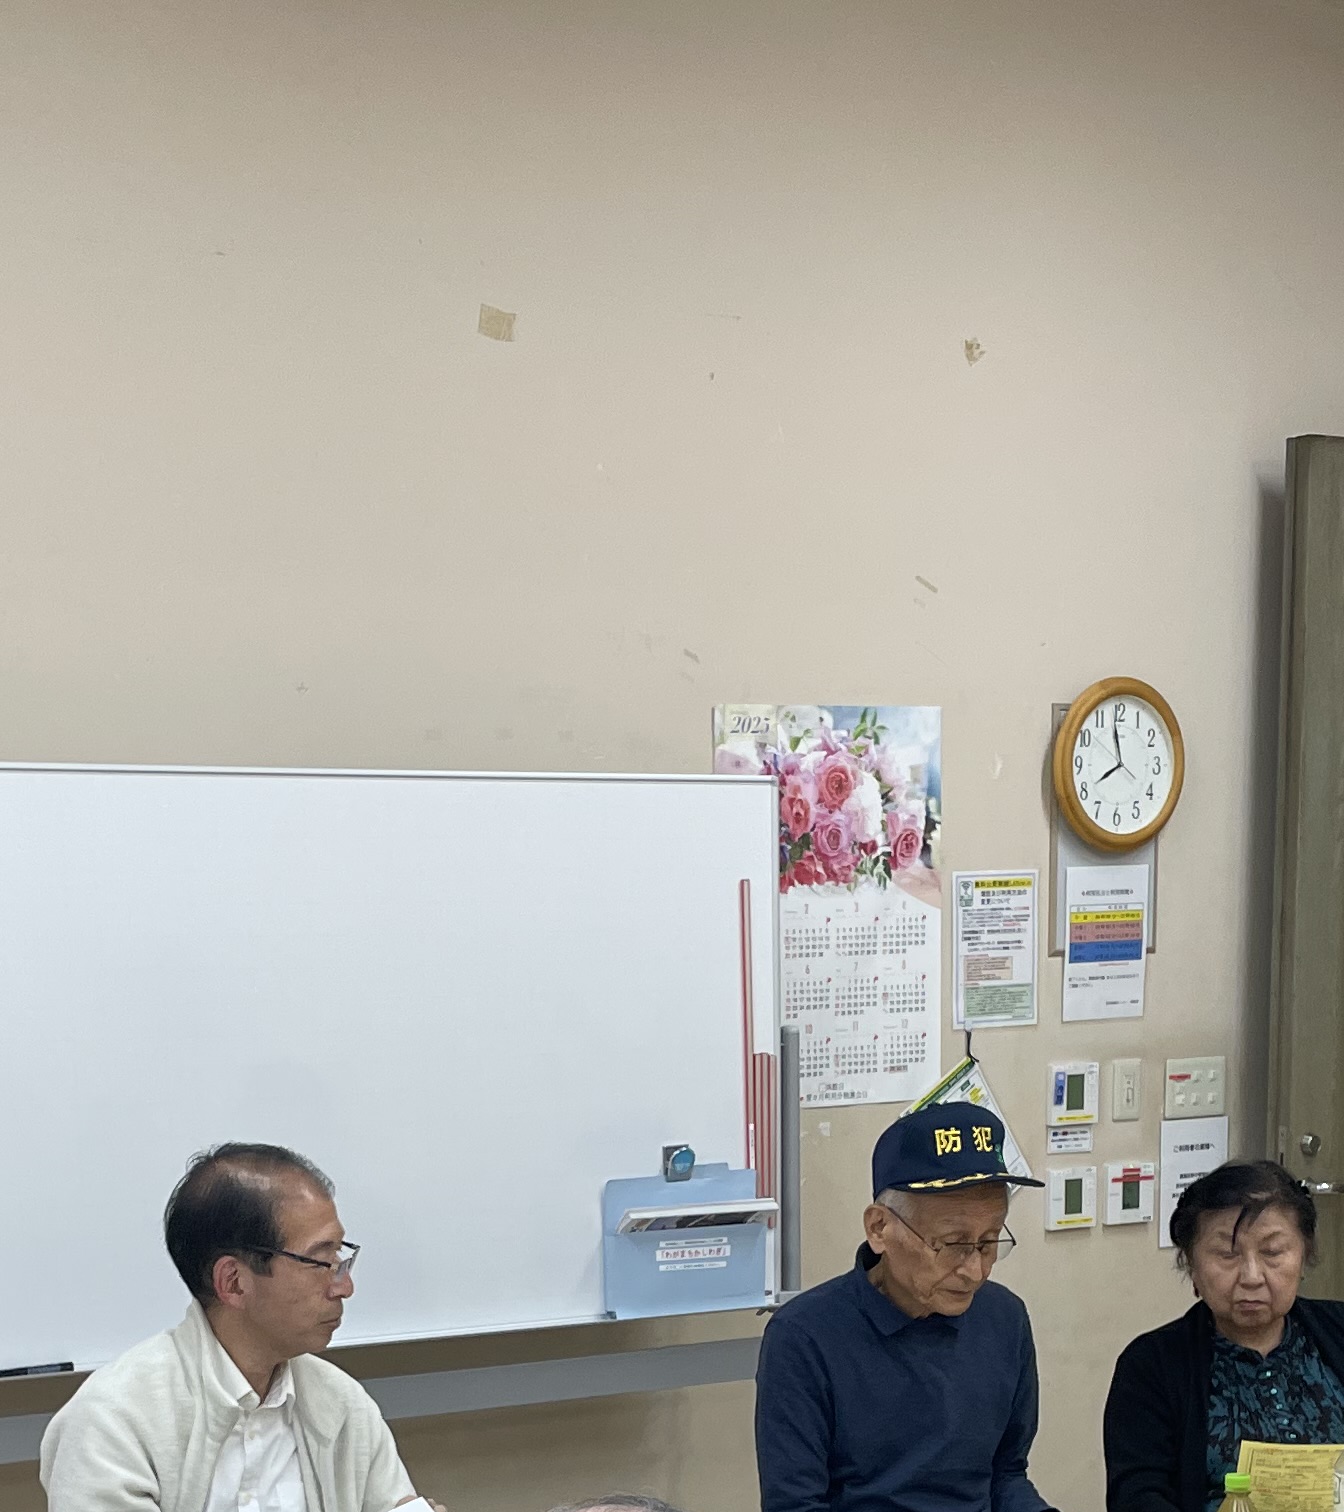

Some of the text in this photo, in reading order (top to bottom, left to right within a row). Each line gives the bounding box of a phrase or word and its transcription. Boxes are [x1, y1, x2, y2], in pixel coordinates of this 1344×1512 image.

[1095, 710, 1104, 728] 11
[1114, 703, 1126, 722] 12
[1135, 711, 1140, 729] 1
[729, 716, 771, 734] 2025
[1079, 728, 1091, 747] 10
[1147, 728, 1156, 747] 2
[1074, 755, 1083, 775] 9
[1152, 756, 1161, 775] 3
[1079, 782, 1088, 800] 8
[1145, 782, 1154, 800] 4
[1094, 801, 1102, 819] 7
[1113, 807, 1121, 826] 6
[1132, 801, 1140, 819] 5
[934, 1126, 993, 1156] 防犯
